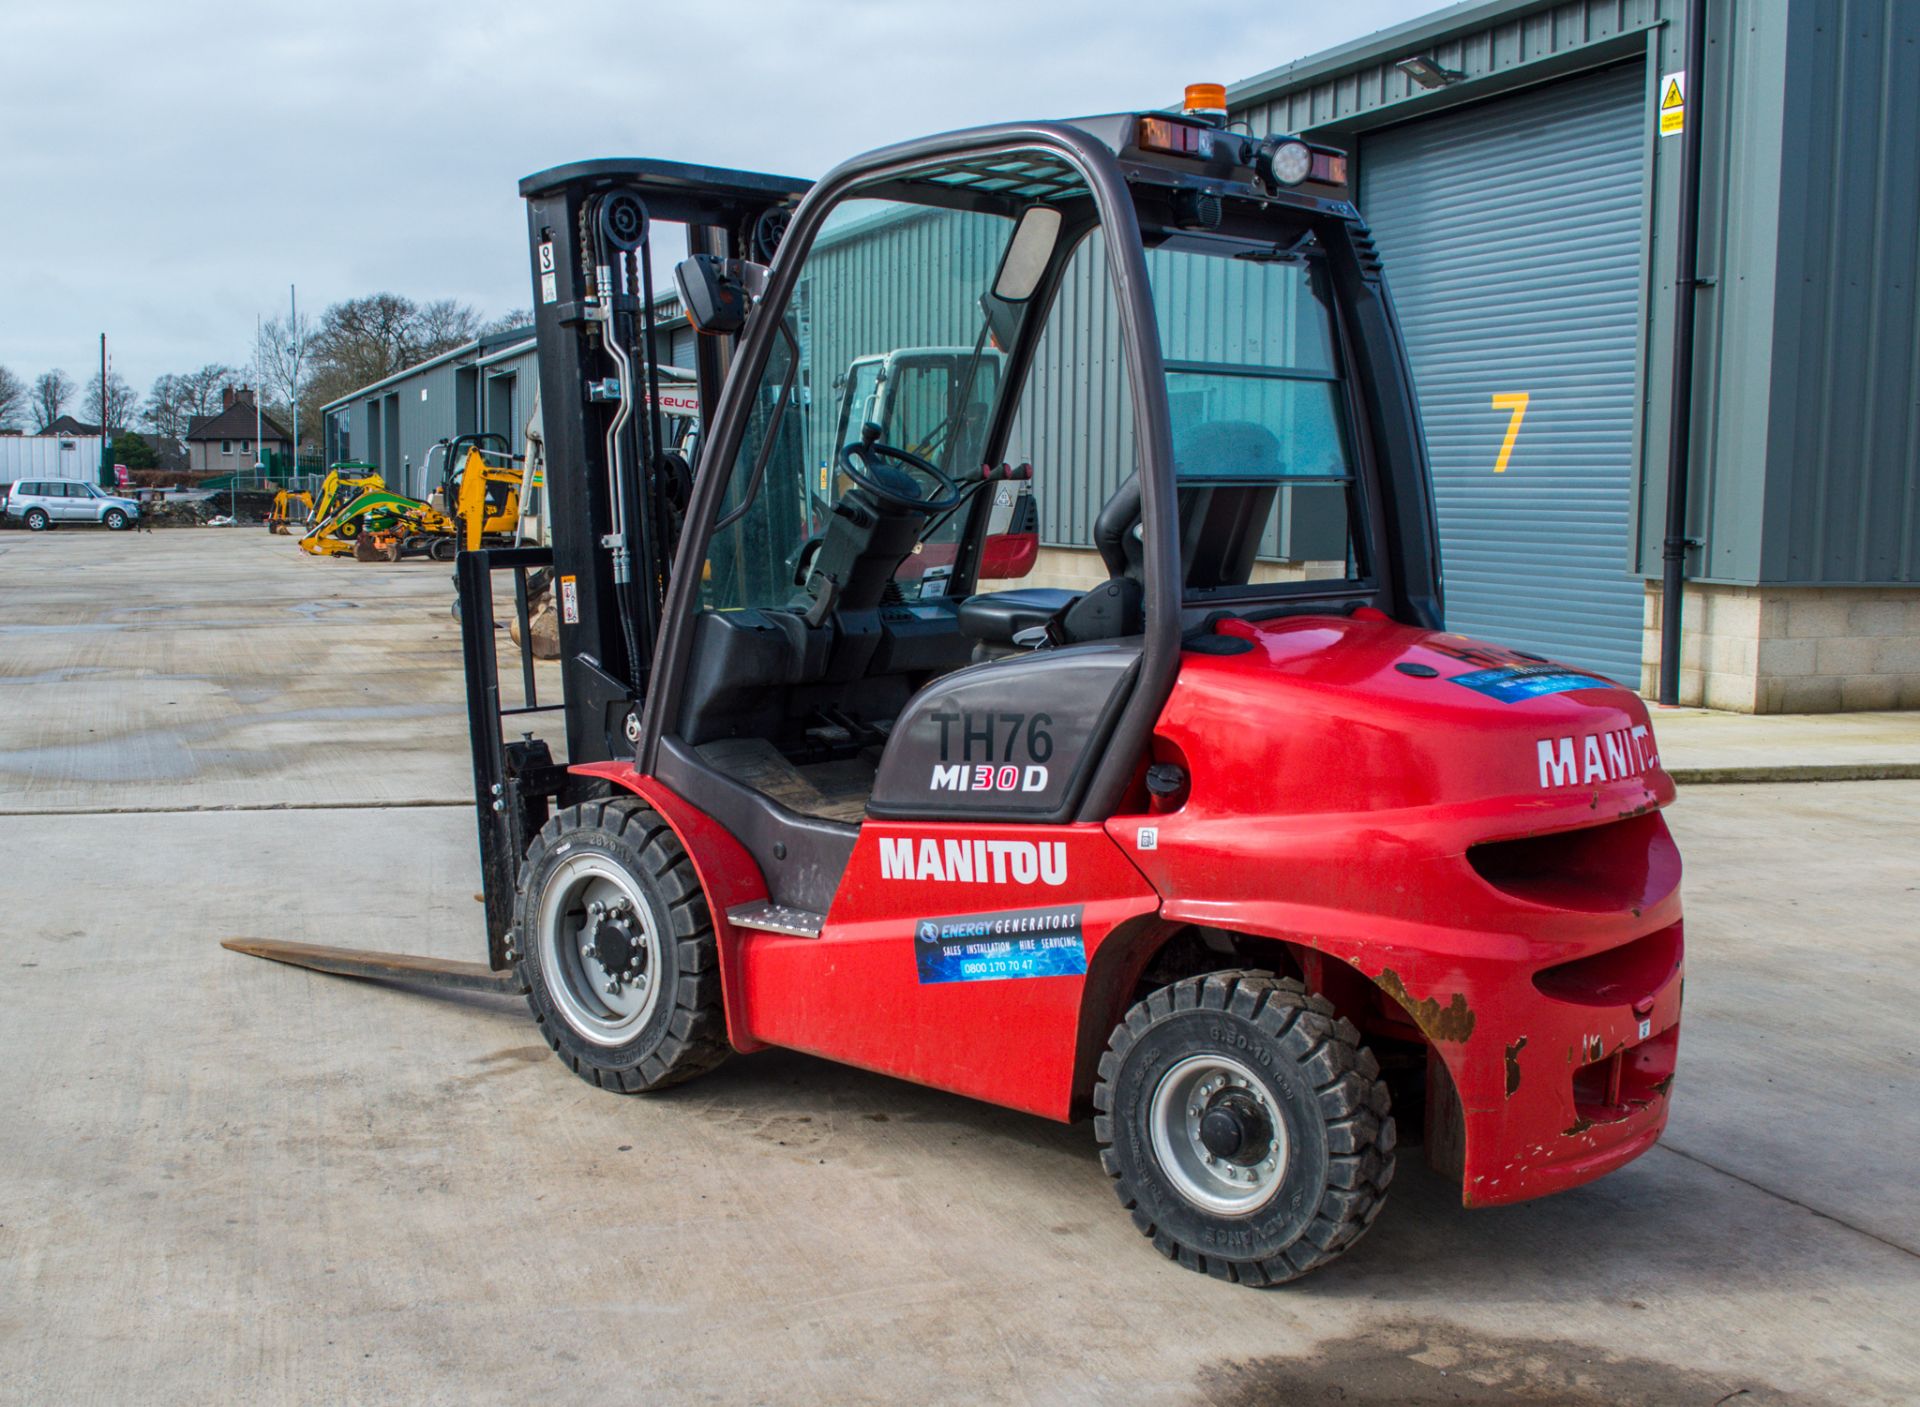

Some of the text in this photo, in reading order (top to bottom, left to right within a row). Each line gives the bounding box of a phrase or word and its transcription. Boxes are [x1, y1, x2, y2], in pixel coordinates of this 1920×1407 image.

[1492, 392, 1529, 473] 7
[931, 712, 1054, 764] TH76
[1537, 724, 1661, 789] MANIT
[879, 837, 1068, 886] MANITOU
[941, 913, 1076, 939] ENERGY GENERATORS
[943, 936, 1077, 956] SALES INSTALLATION HIRE SERVICING
[964, 959, 1033, 974] 0800 170 70 47
